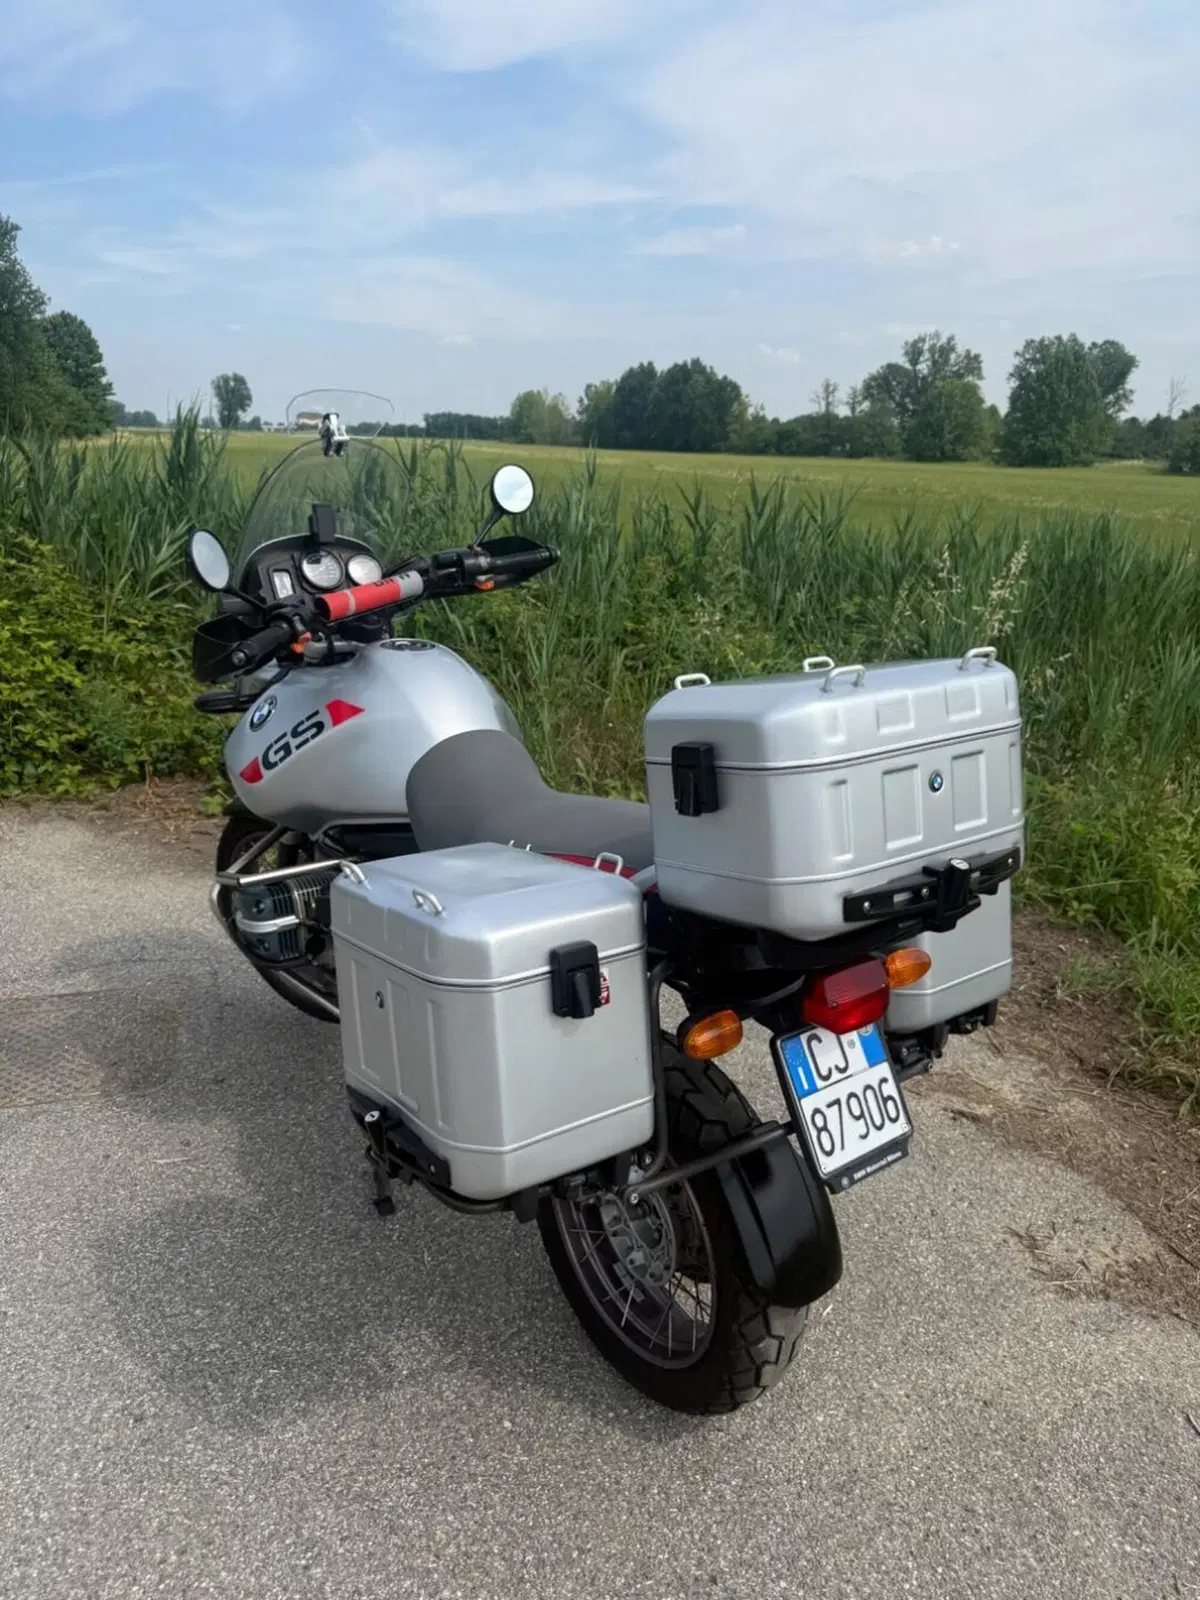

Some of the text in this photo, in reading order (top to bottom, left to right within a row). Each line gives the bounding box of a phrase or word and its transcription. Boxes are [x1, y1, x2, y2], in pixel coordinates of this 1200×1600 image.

[262, 709, 325, 771] GS
[806, 1032, 850, 1082] CJ
[810, 1076, 901, 1157] 87906
